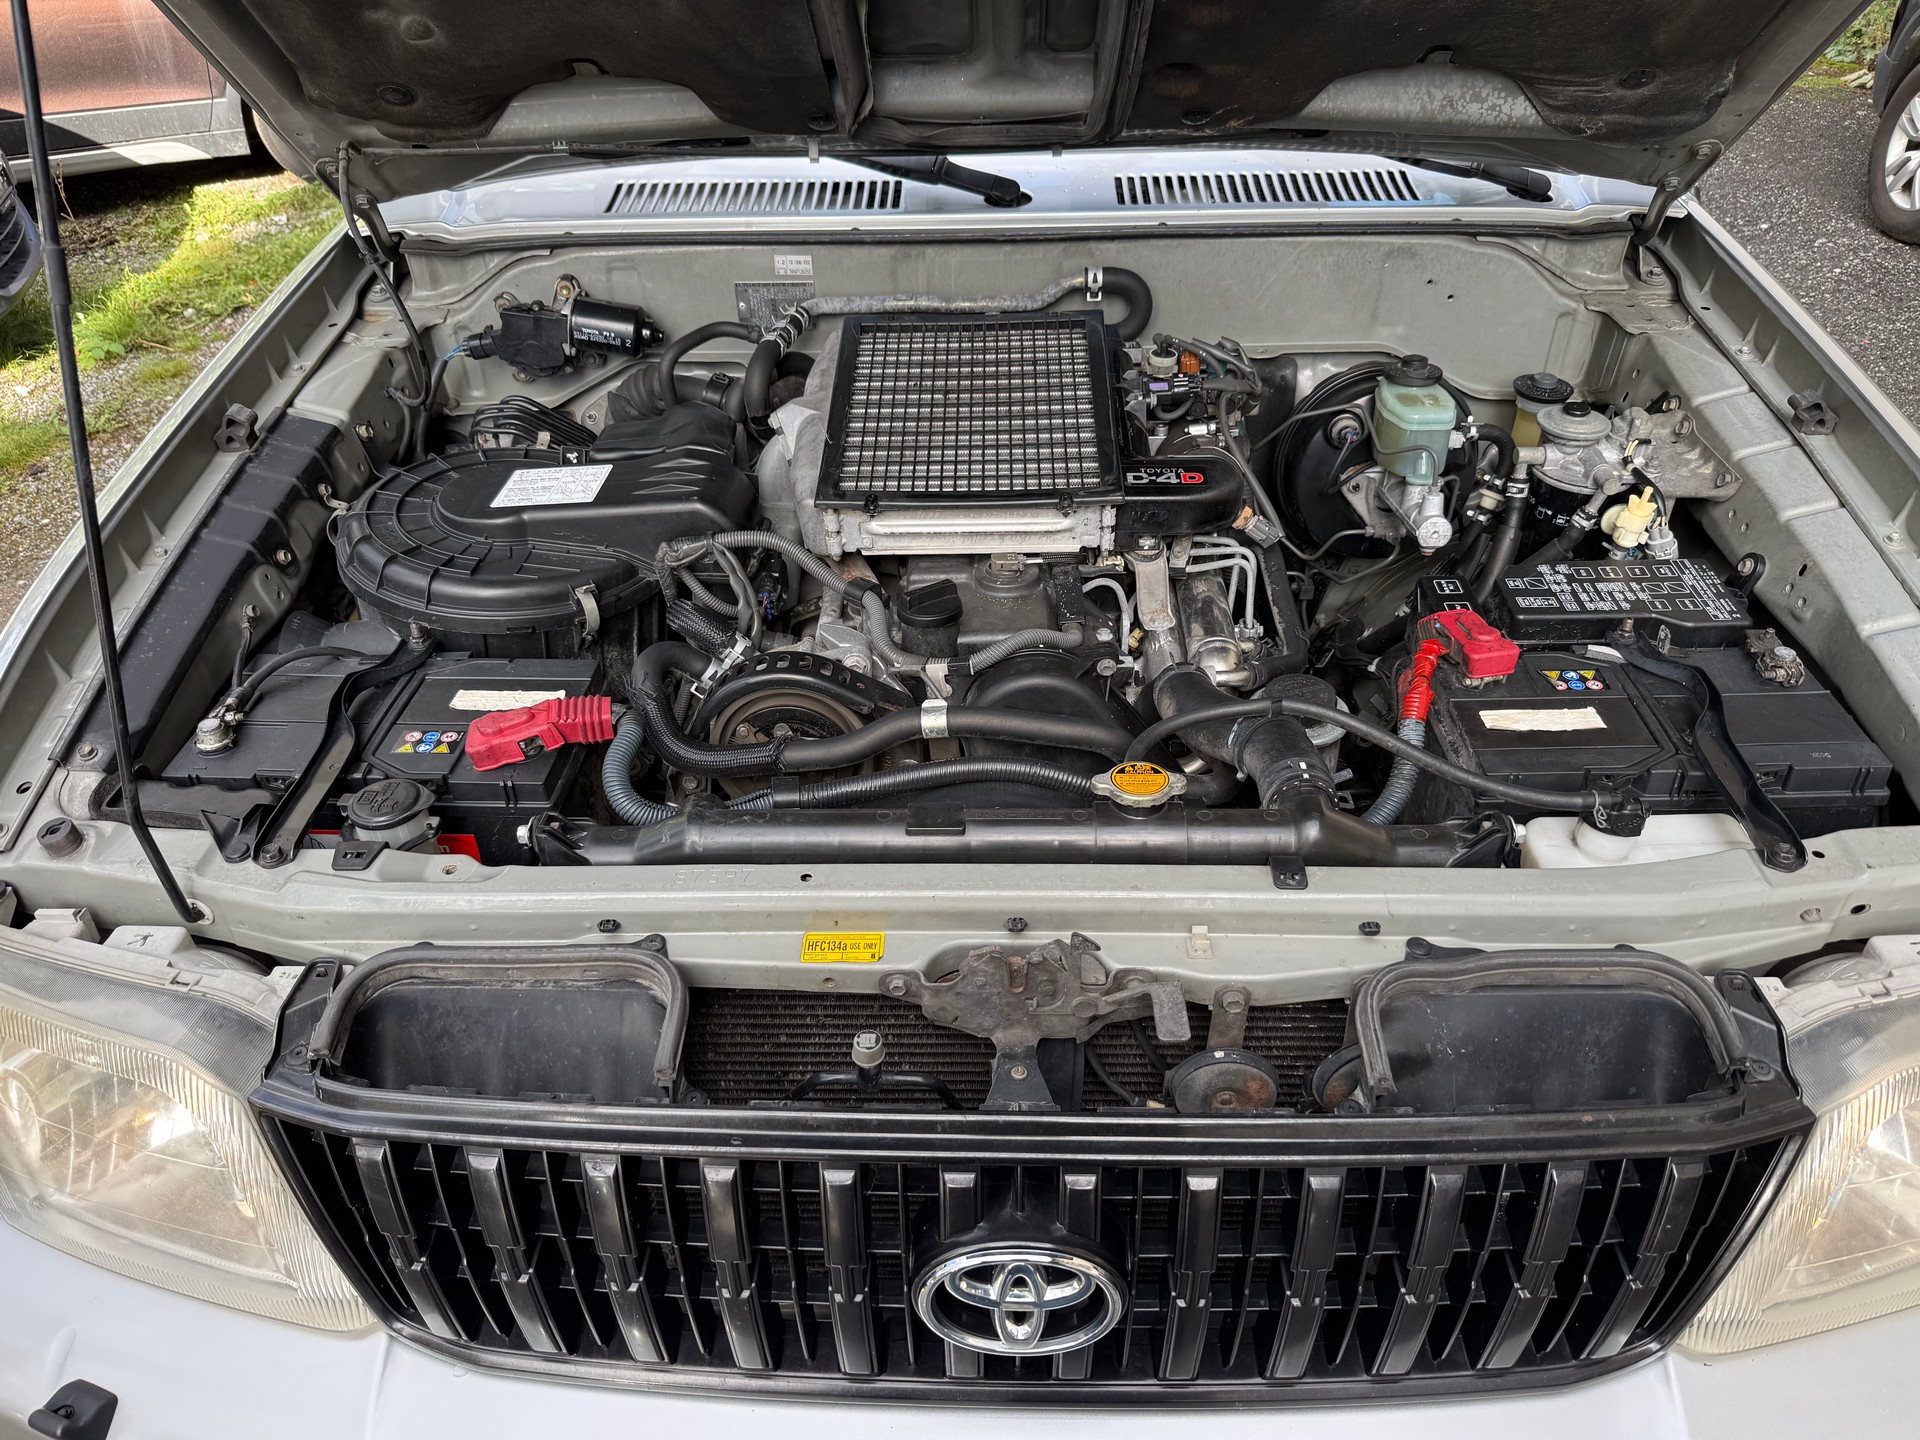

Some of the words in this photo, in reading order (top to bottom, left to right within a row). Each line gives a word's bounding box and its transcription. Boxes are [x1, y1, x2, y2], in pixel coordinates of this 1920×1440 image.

[625, 340, 632, 348] 2
[1126, 472, 1204, 484] D-4D
[807, 940, 848, 952] HFC134a
[863, 942, 878, 950] ONLY
